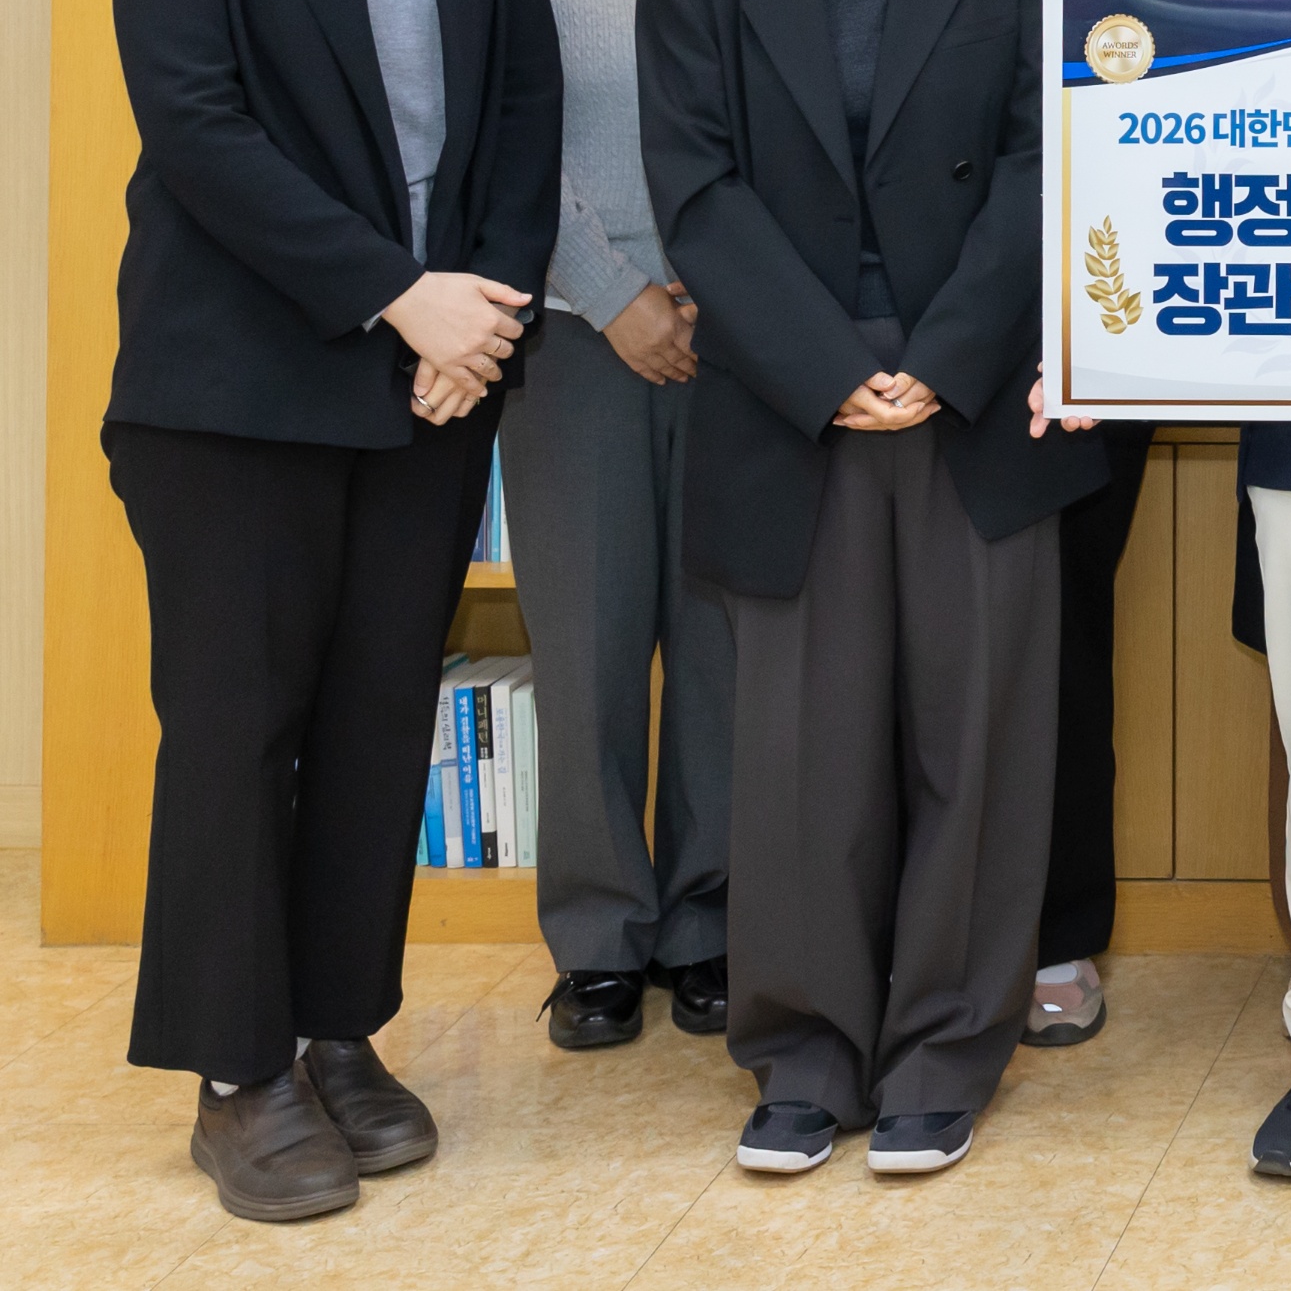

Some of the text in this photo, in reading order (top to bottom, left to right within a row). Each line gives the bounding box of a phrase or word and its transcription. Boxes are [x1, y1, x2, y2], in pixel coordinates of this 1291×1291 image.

[1102, 41, 1139, 50] AWORDS
[1103, 50, 1137, 59] WINNER
[1118, 111, 1206, 145] 2026
